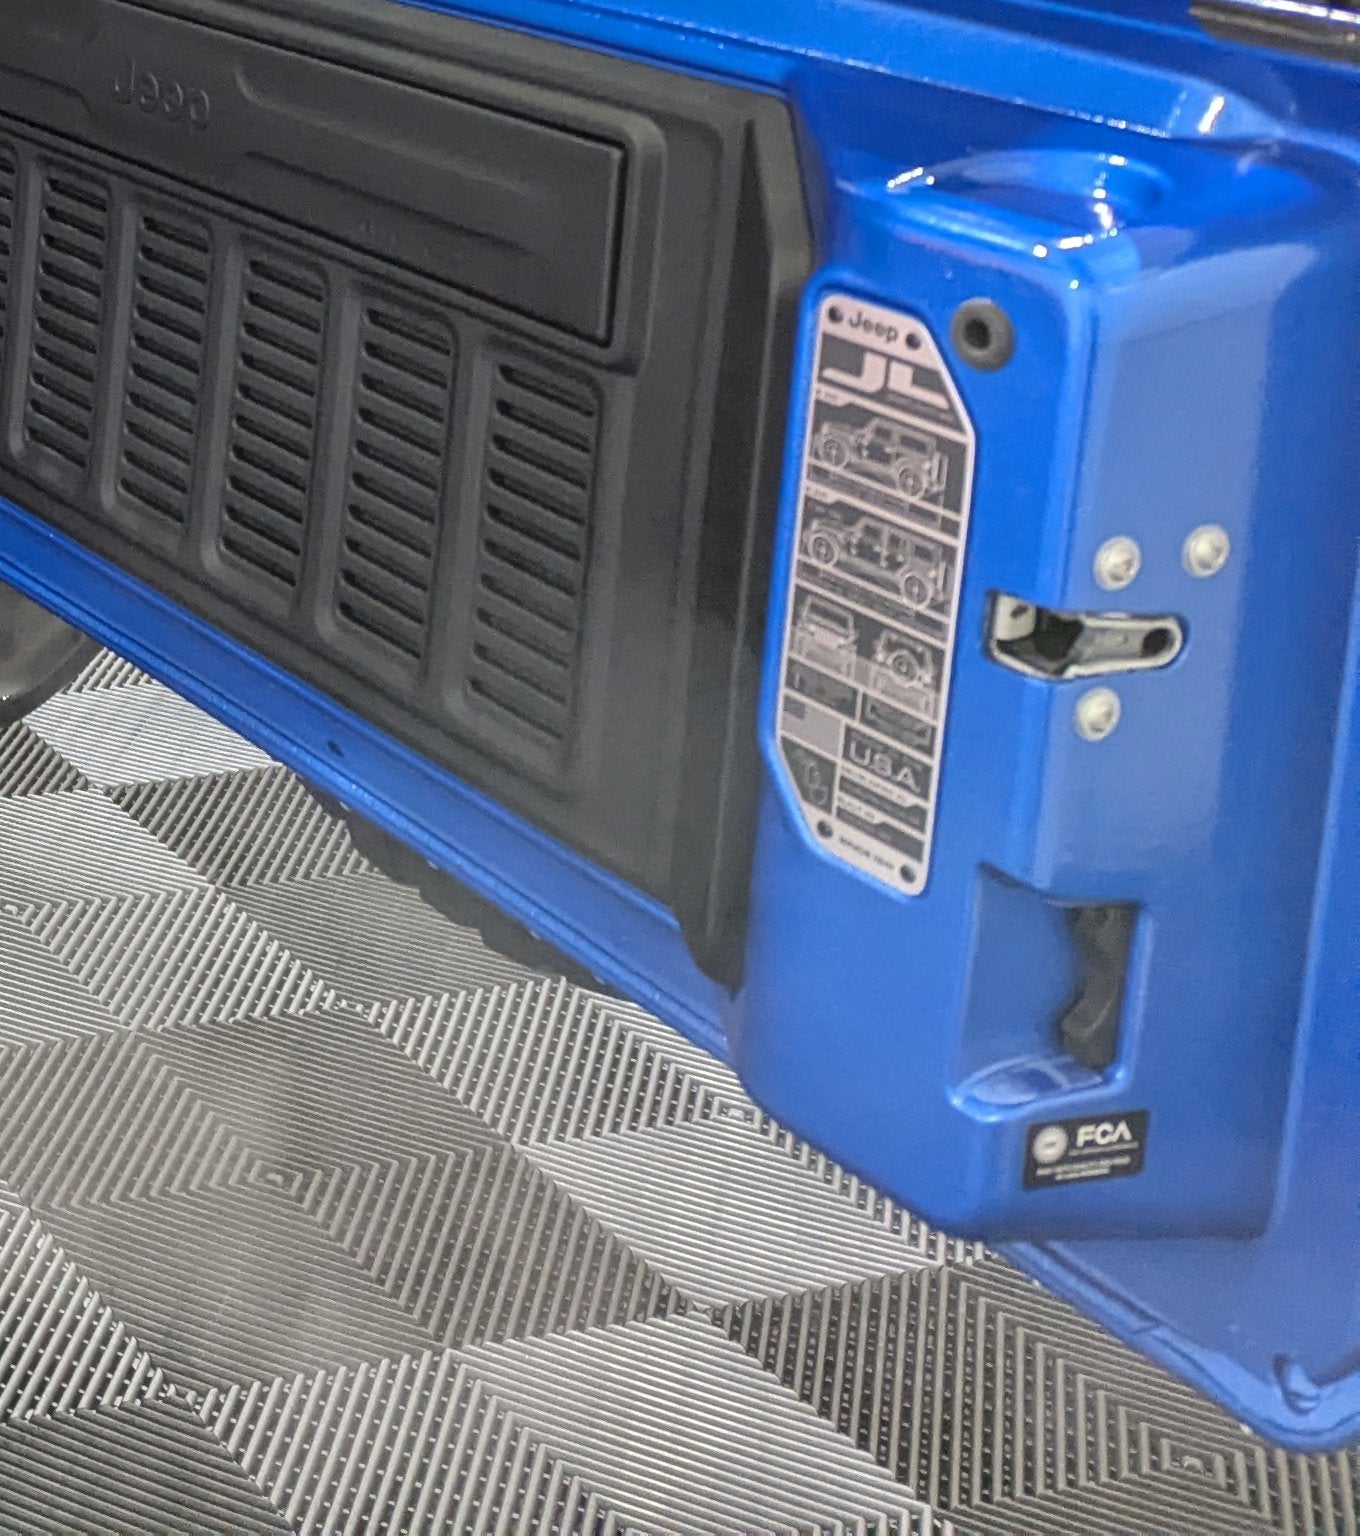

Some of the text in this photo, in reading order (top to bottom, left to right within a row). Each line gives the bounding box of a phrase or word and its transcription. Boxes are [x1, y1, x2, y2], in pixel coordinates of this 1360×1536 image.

[848, 311, 899, 343] Jeep
[821, 350, 950, 410] JL
[848, 739, 922, 795] USA
[1076, 1119, 1132, 1148] FCA
